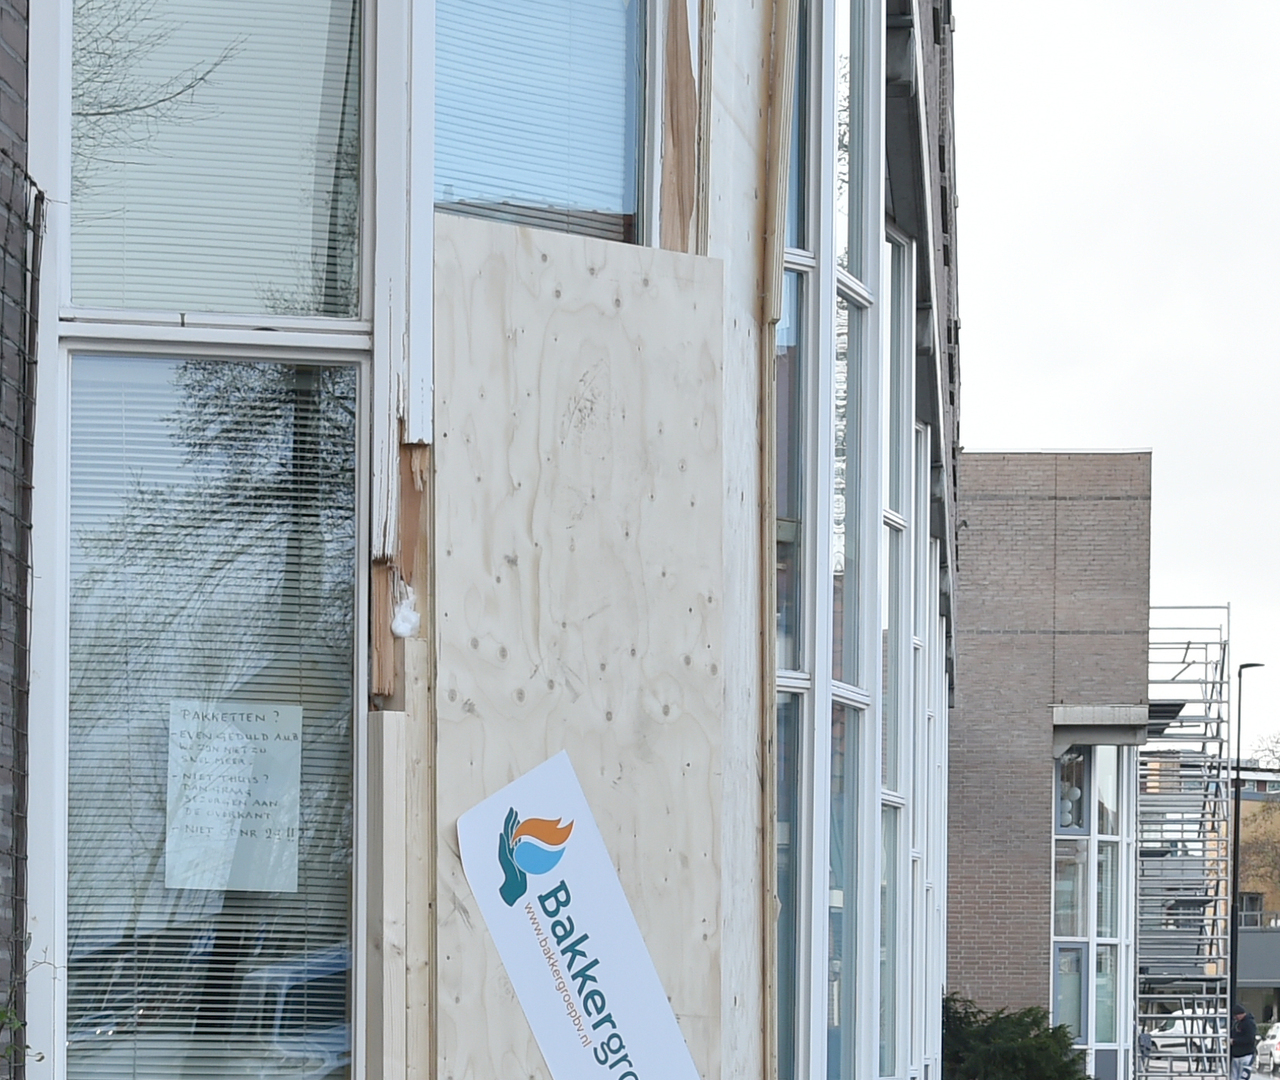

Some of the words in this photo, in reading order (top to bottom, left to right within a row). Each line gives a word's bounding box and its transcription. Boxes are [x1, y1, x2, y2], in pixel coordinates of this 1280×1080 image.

[181, 709, 266, 723] PAKKETTEN
[179, 730, 213, 741] EVEN
[217, 732, 269, 742] GEDULD
[183, 772, 214, 782] NIET
[252, 799, 278, 808] AAN
[185, 824, 214, 834] NIET
[240, 829, 258, 838] NR
[524, 902, 593, 1048] www.bakkergroepbv.nl
